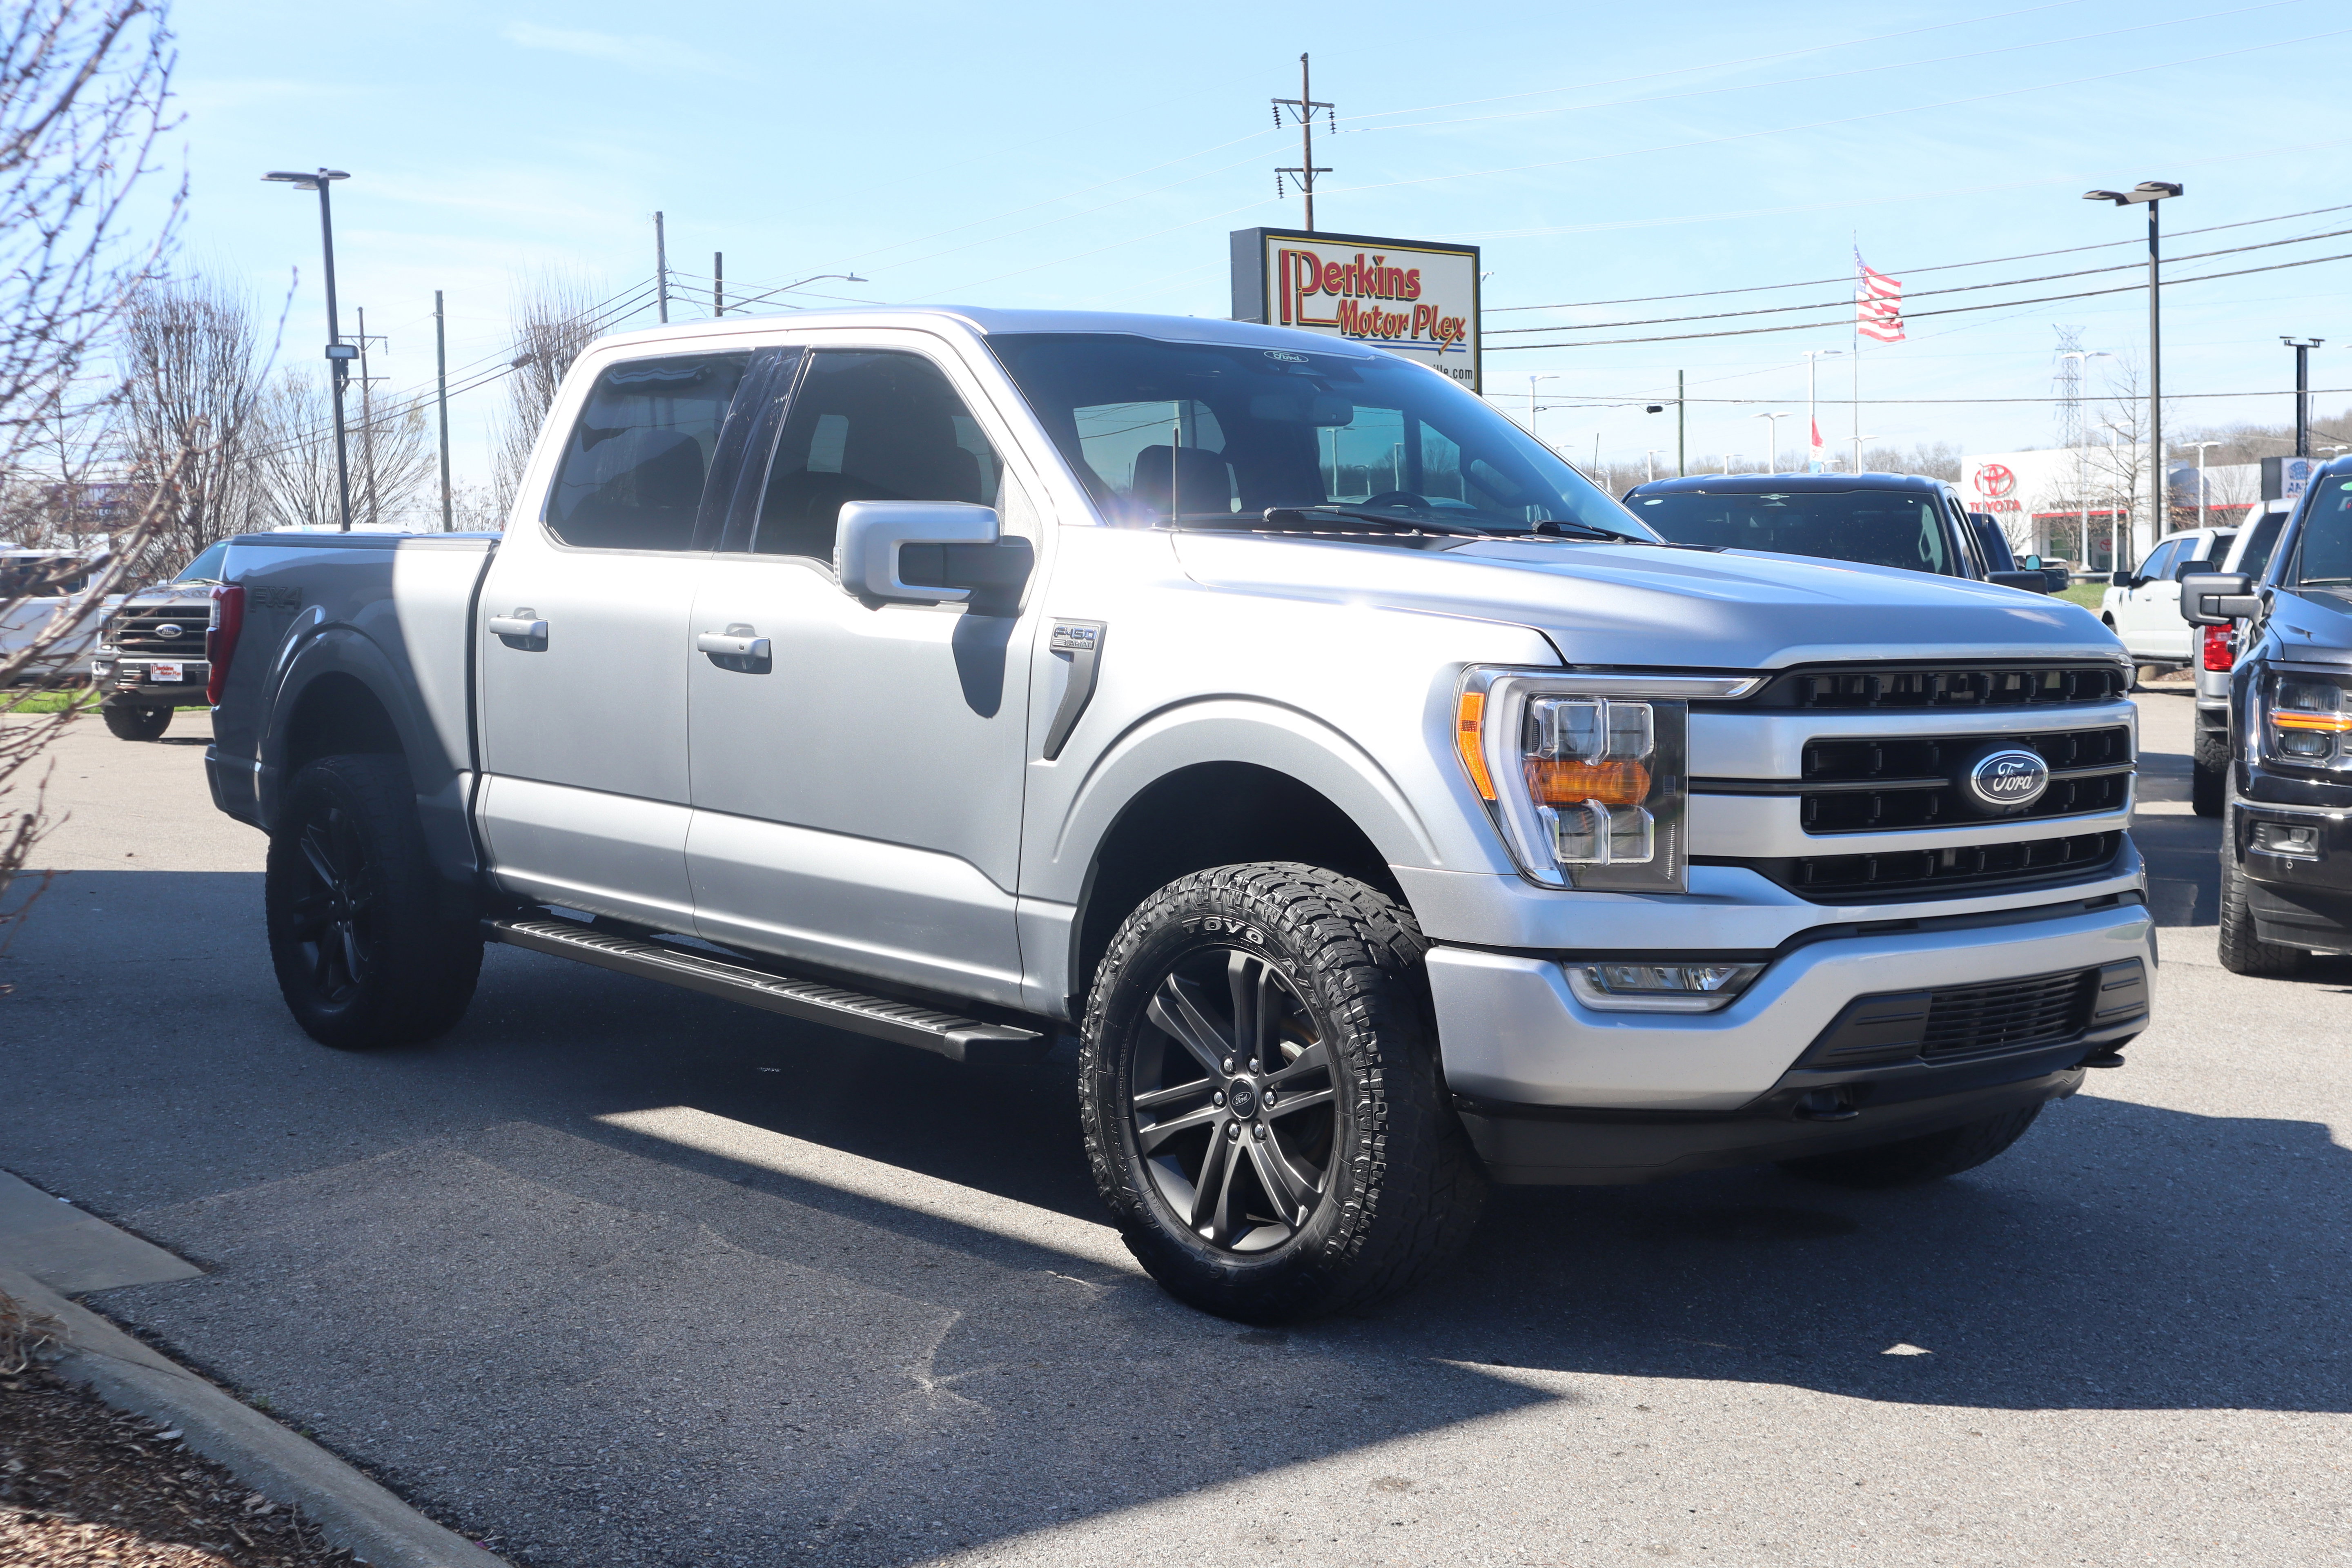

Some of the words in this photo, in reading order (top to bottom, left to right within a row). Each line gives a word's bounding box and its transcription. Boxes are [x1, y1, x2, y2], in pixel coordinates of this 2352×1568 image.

[1279, 248, 1421, 325] Perkins
[1339, 299, 1410, 340] Motor
[1412, 304, 1467, 356] Plex
[1272, 352, 1302, 361] Ford
[249, 586, 303, 612] FX4
[1054, 626, 1097, 640] F-150
[1065, 639, 1092, 648] LARIAT
[1993, 762, 2034, 792] Ford
[1181, 916, 1265, 946] TOYO
[1235, 1094, 1248, 1105] Ford
